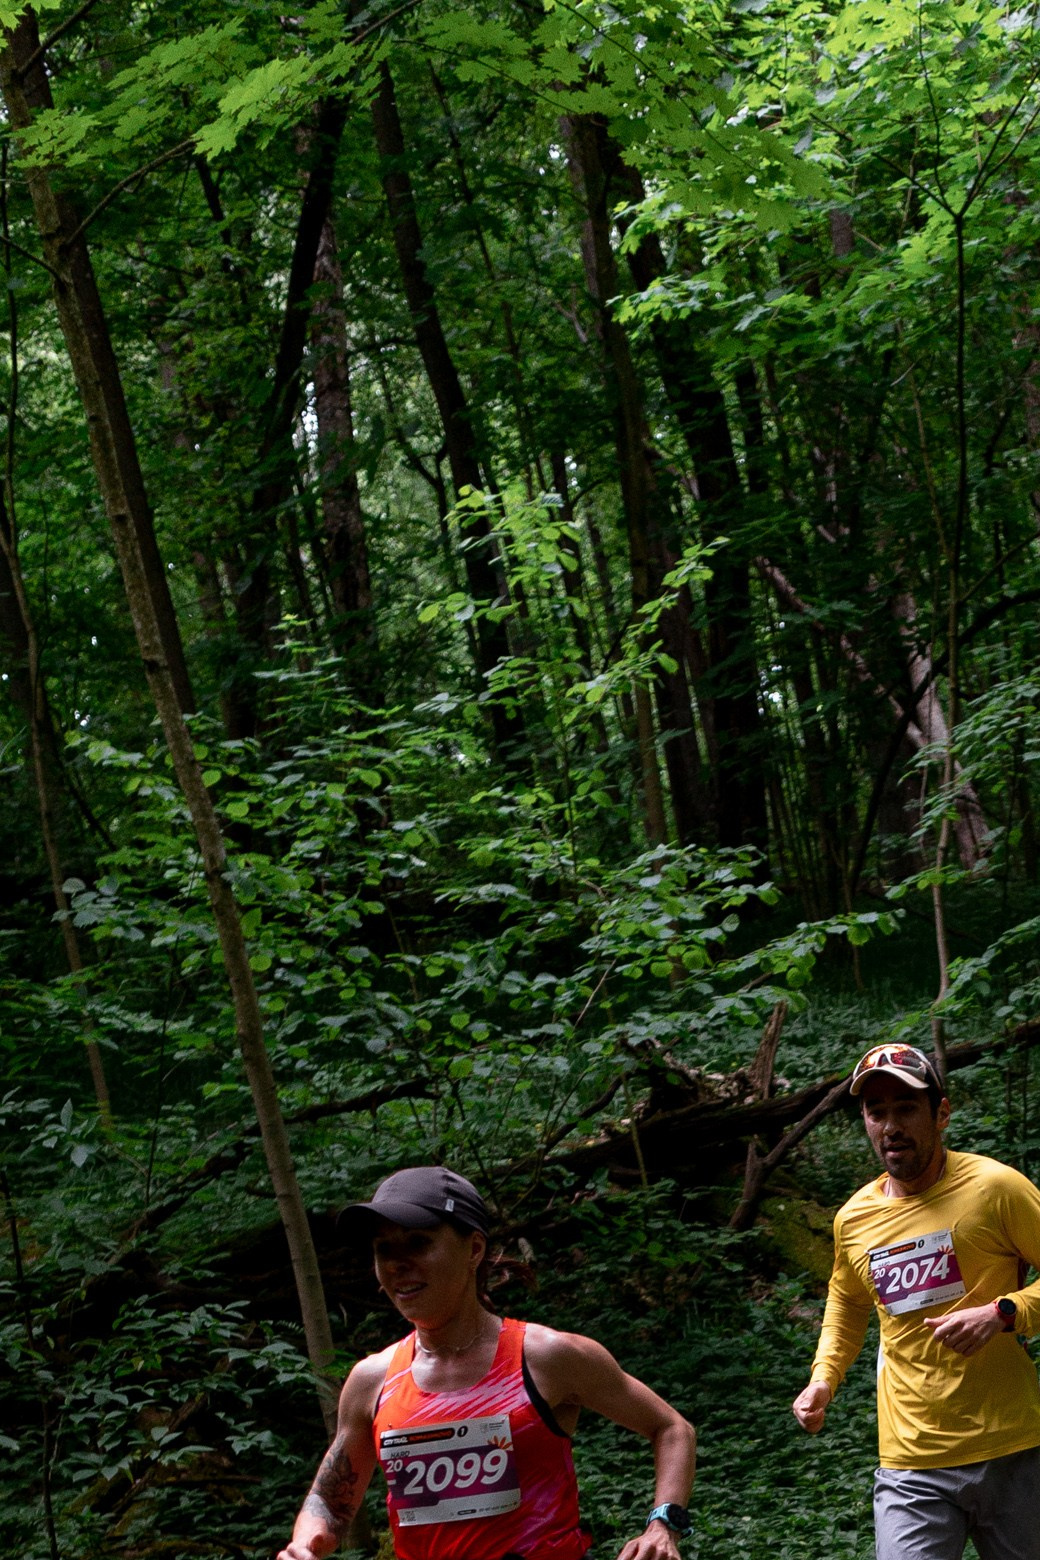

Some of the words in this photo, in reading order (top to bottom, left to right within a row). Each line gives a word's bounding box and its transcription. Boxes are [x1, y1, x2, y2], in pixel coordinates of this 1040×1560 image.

[874, 1267, 885, 1279] 20
[886, 1254, 950, 1294] 2074
[390, 1450, 410, 1459] HARD
[386, 1459, 403, 1473] 20
[404, 1449, 508, 1495] 2099
